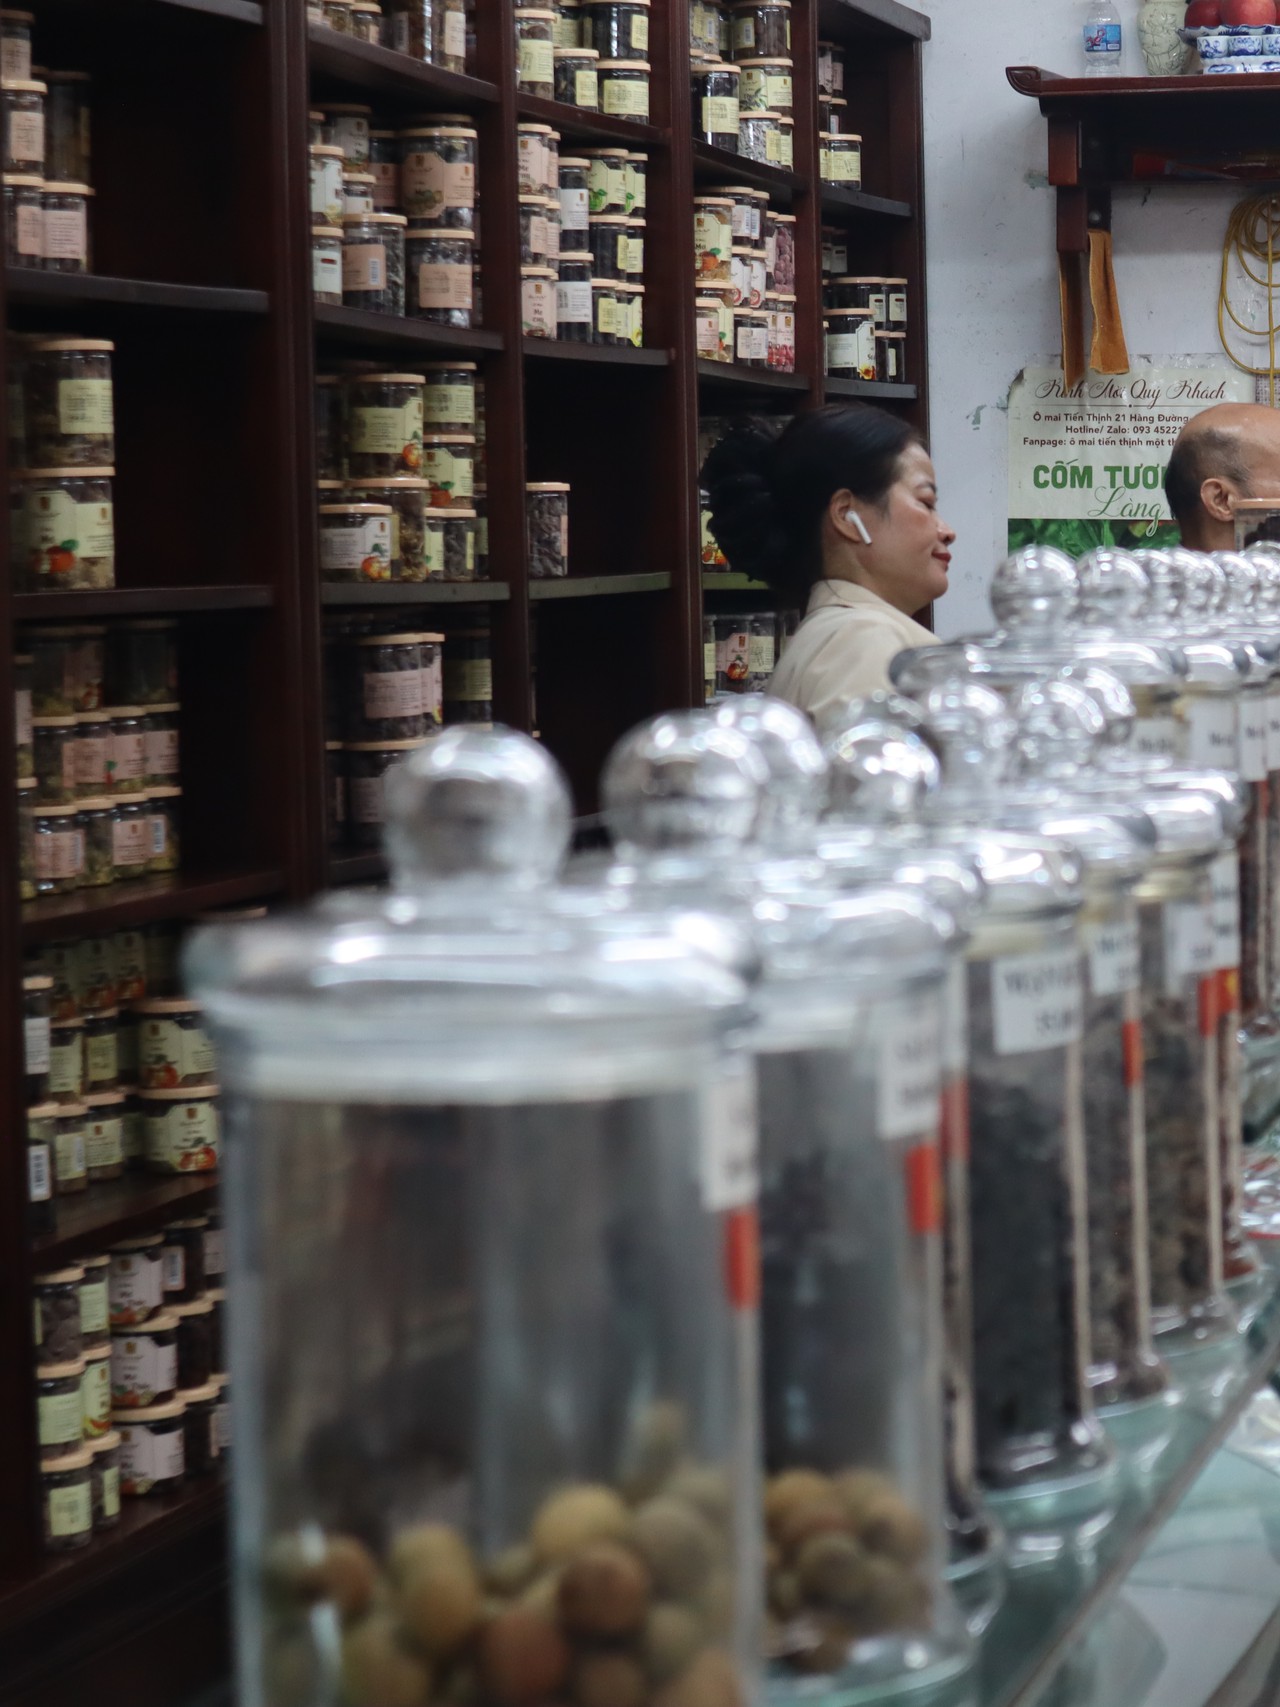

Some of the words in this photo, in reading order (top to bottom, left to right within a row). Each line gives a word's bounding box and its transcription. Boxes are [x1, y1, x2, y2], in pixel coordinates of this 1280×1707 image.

[1130, 379, 1161, 409] Quý
[1165, 379, 1227, 399] Khách
[1033, 411, 1042, 422] Ô
[1044, 413, 1061, 421] mai
[1063, 412, 1084, 421] Tiến
[1086, 413, 1112, 424] Thịnh
[1114, 413, 1126, 422] 21
[1129, 413, 1155, 424] Hàng
[1065, 425, 1104, 434] Hotline/
[1106, 426, 1130, 434] Zalo:
[1132, 426, 1151, 434] 093
[1023, 437, 1067, 447] Fanpage:
[1069, 437, 1076, 446] ô
[1078, 438, 1096, 446] mai
[1097, 436, 1116, 446] tiến
[1118, 438, 1143, 448] thịnh
[1145, 438, 1165, 449] một
[1033, 459, 1093, 489] CỐM
[1087, 485, 1165, 537] Làng
